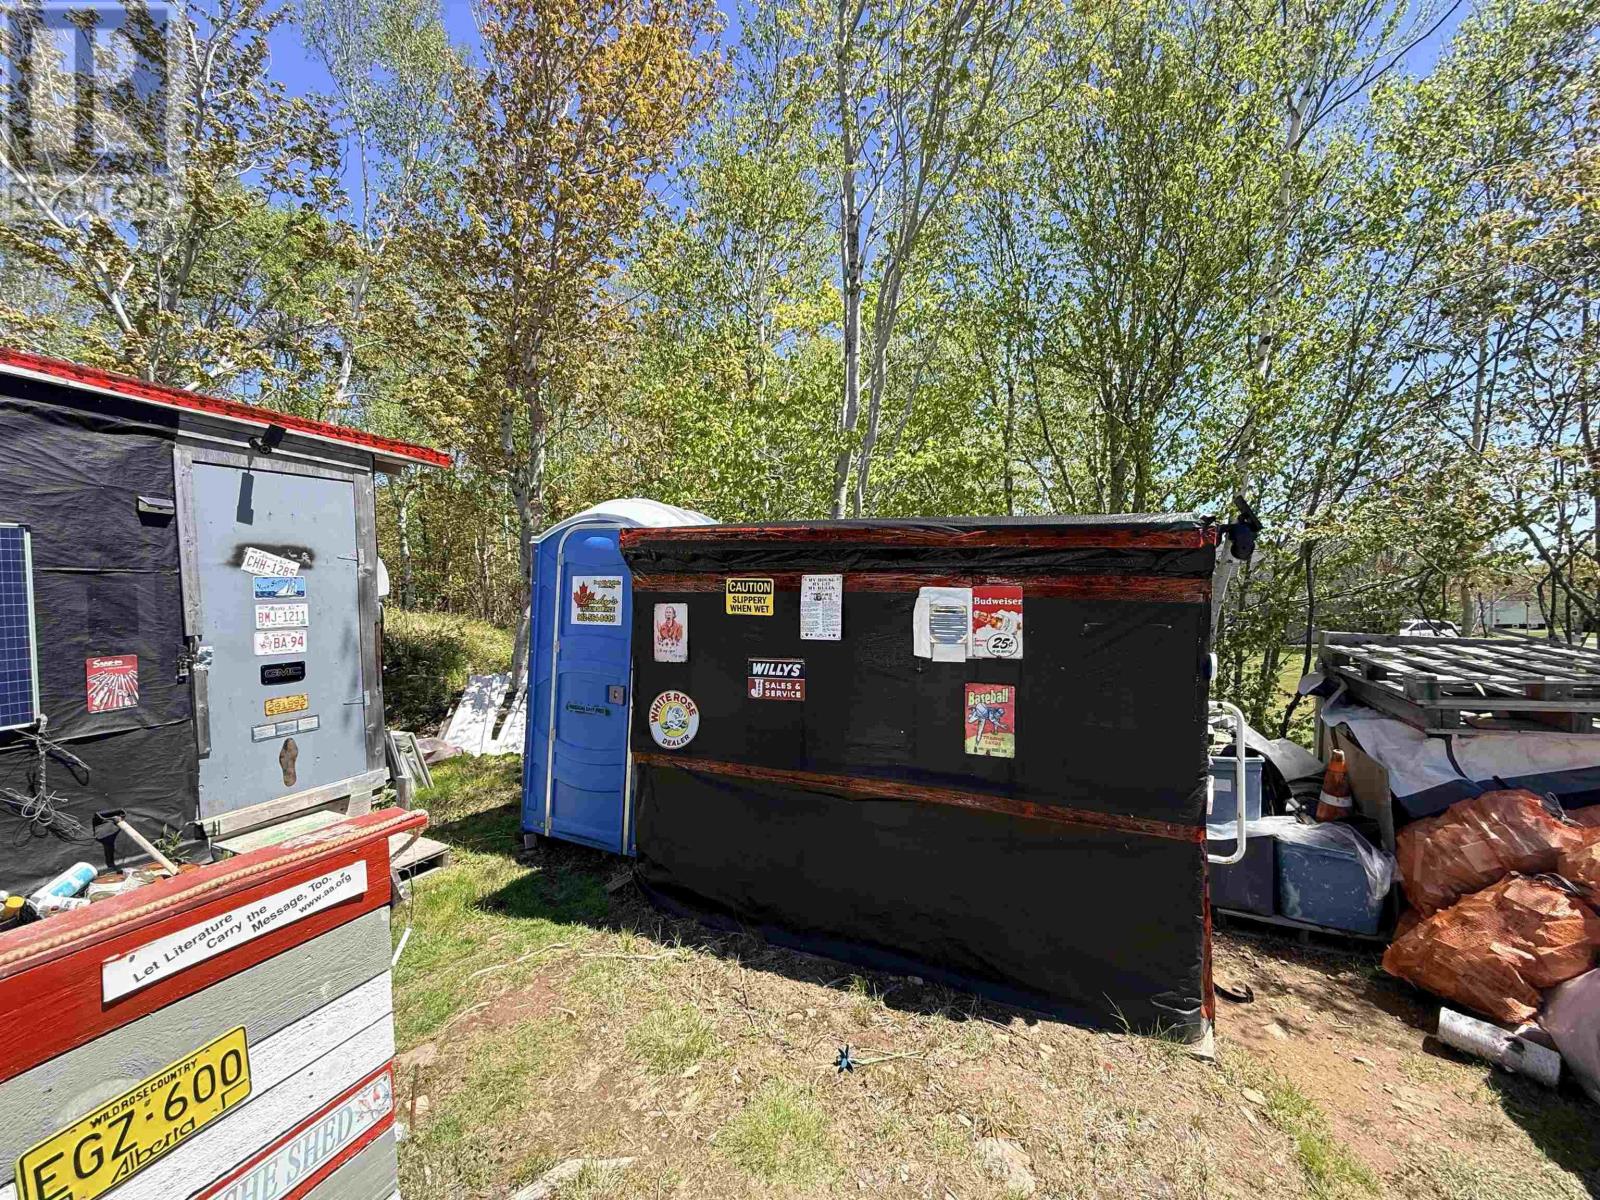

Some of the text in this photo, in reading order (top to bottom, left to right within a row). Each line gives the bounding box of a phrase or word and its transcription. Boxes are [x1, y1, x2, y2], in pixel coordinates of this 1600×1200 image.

[729, 581, 771, 593] CAUTION
[732, 595, 767, 604] SLIPPERY
[973, 596, 1024, 606] Budweiser
[730, 604, 770, 613] WHEN WET
[257, 610, 307, 624] BMJ-1211
[992, 636, 1014, 650] 25¢
[264, 666, 302, 678] GMC
[752, 662, 802, 677] WILLYS
[764, 681, 792, 690] SALES
[765, 690, 802, 698] SERVICE
[968, 687, 1009, 706] Baseball
[651, 692, 697, 723] WHITE ROSE
[662, 734, 691, 747] DEALER
[298, 872, 353, 914] www.aa.org
[251, 875, 333, 934] Message, Too.
[206, 905, 268, 950] Carry the
[132, 913, 233, 983] Let Literature
[90, 1058, 198, 1129] WILD ROSE COUNTRY
[111, 1116, 196, 1185] Alberta
[286, 1105, 354, 1187] SHED
